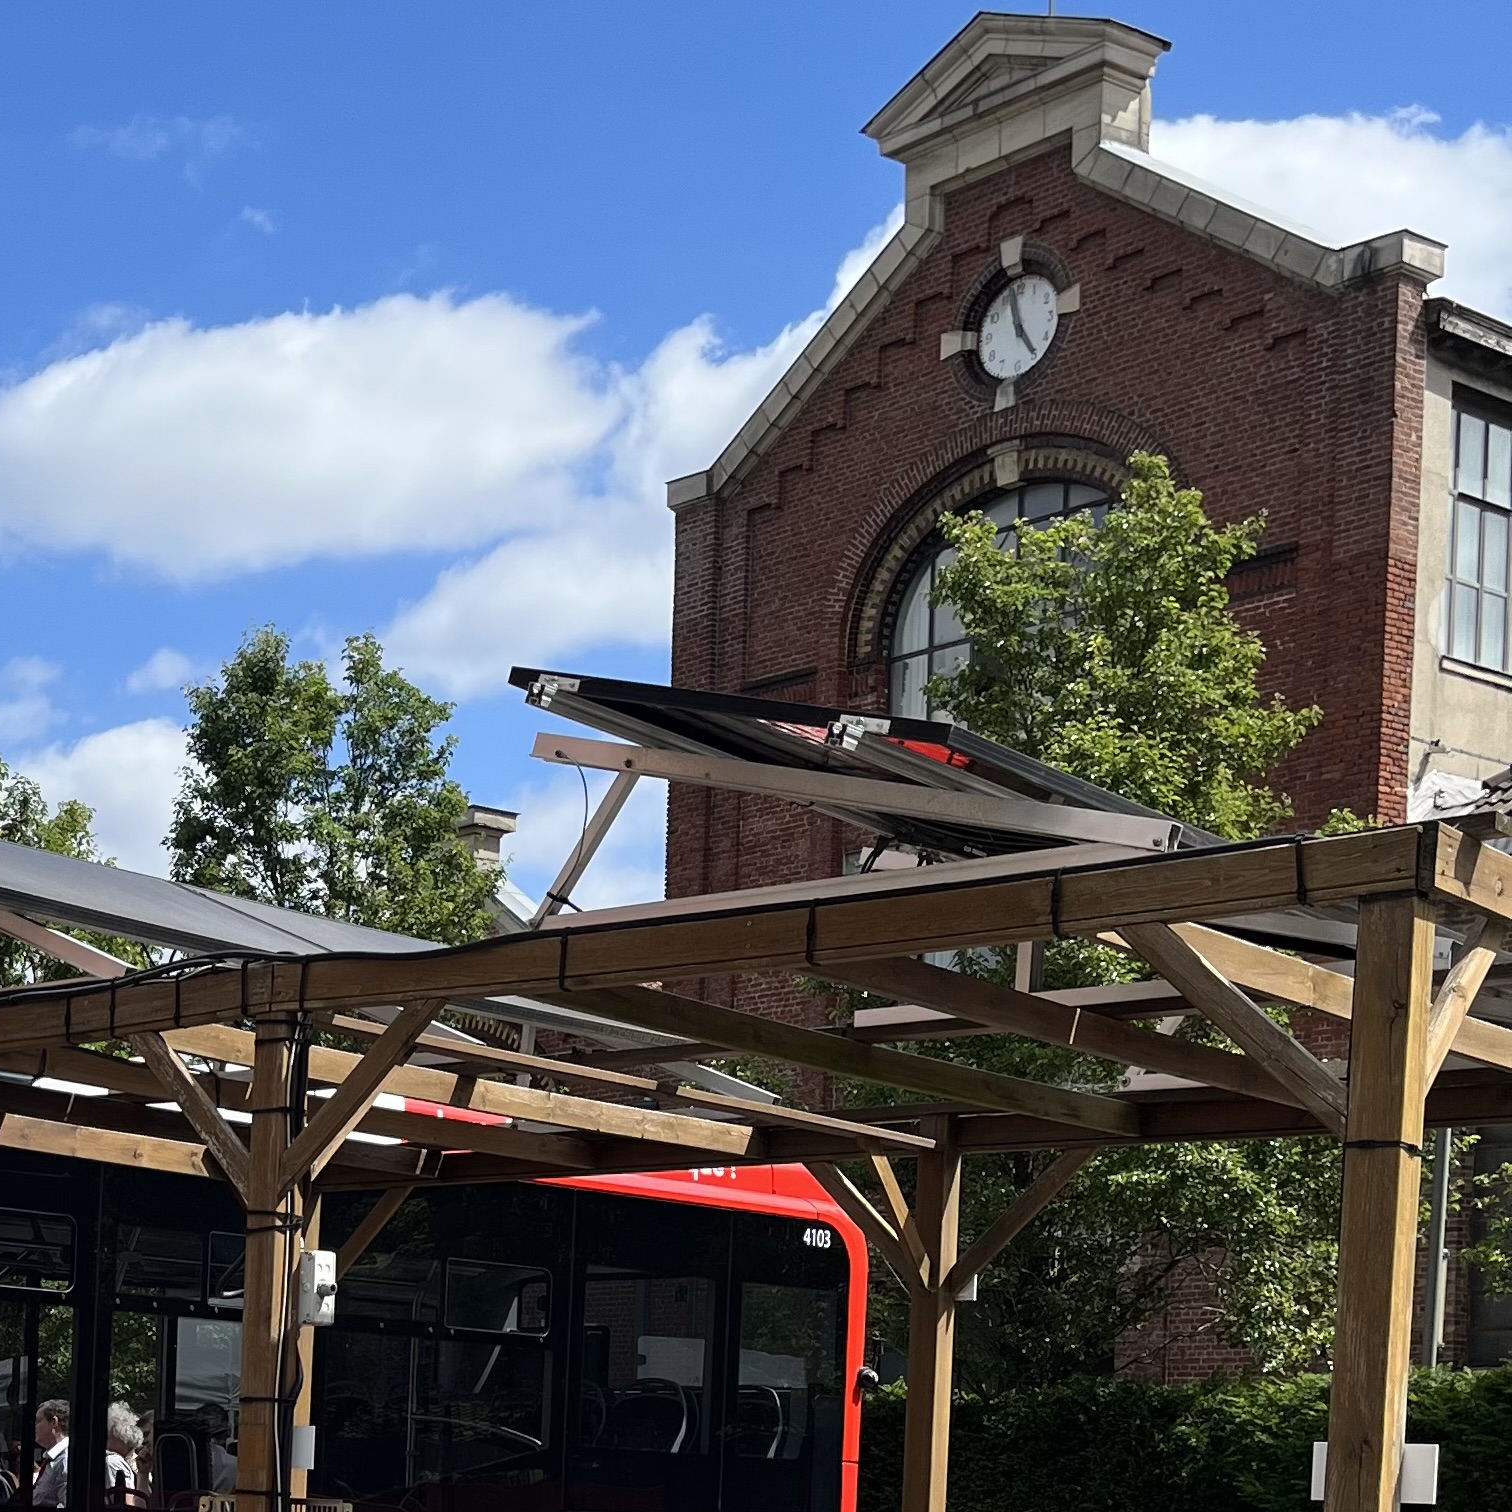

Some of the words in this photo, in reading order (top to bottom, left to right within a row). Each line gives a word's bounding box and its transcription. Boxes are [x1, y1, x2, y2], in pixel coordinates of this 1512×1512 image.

[1016, 282, 1026, 295] 12
[1043, 292, 1050, 305] 2
[990, 311, 1000, 324] 10
[1047, 310, 1054, 322] 3
[985, 332, 993, 345] 9
[1042, 330, 1049, 341] 4
[988, 349, 996, 362] 8
[1030, 348, 1038, 361] 5
[998, 359, 1006, 372] 7
[1014, 359, 1022, 372] 6
[802, 1228, 831, 1249] 4103
